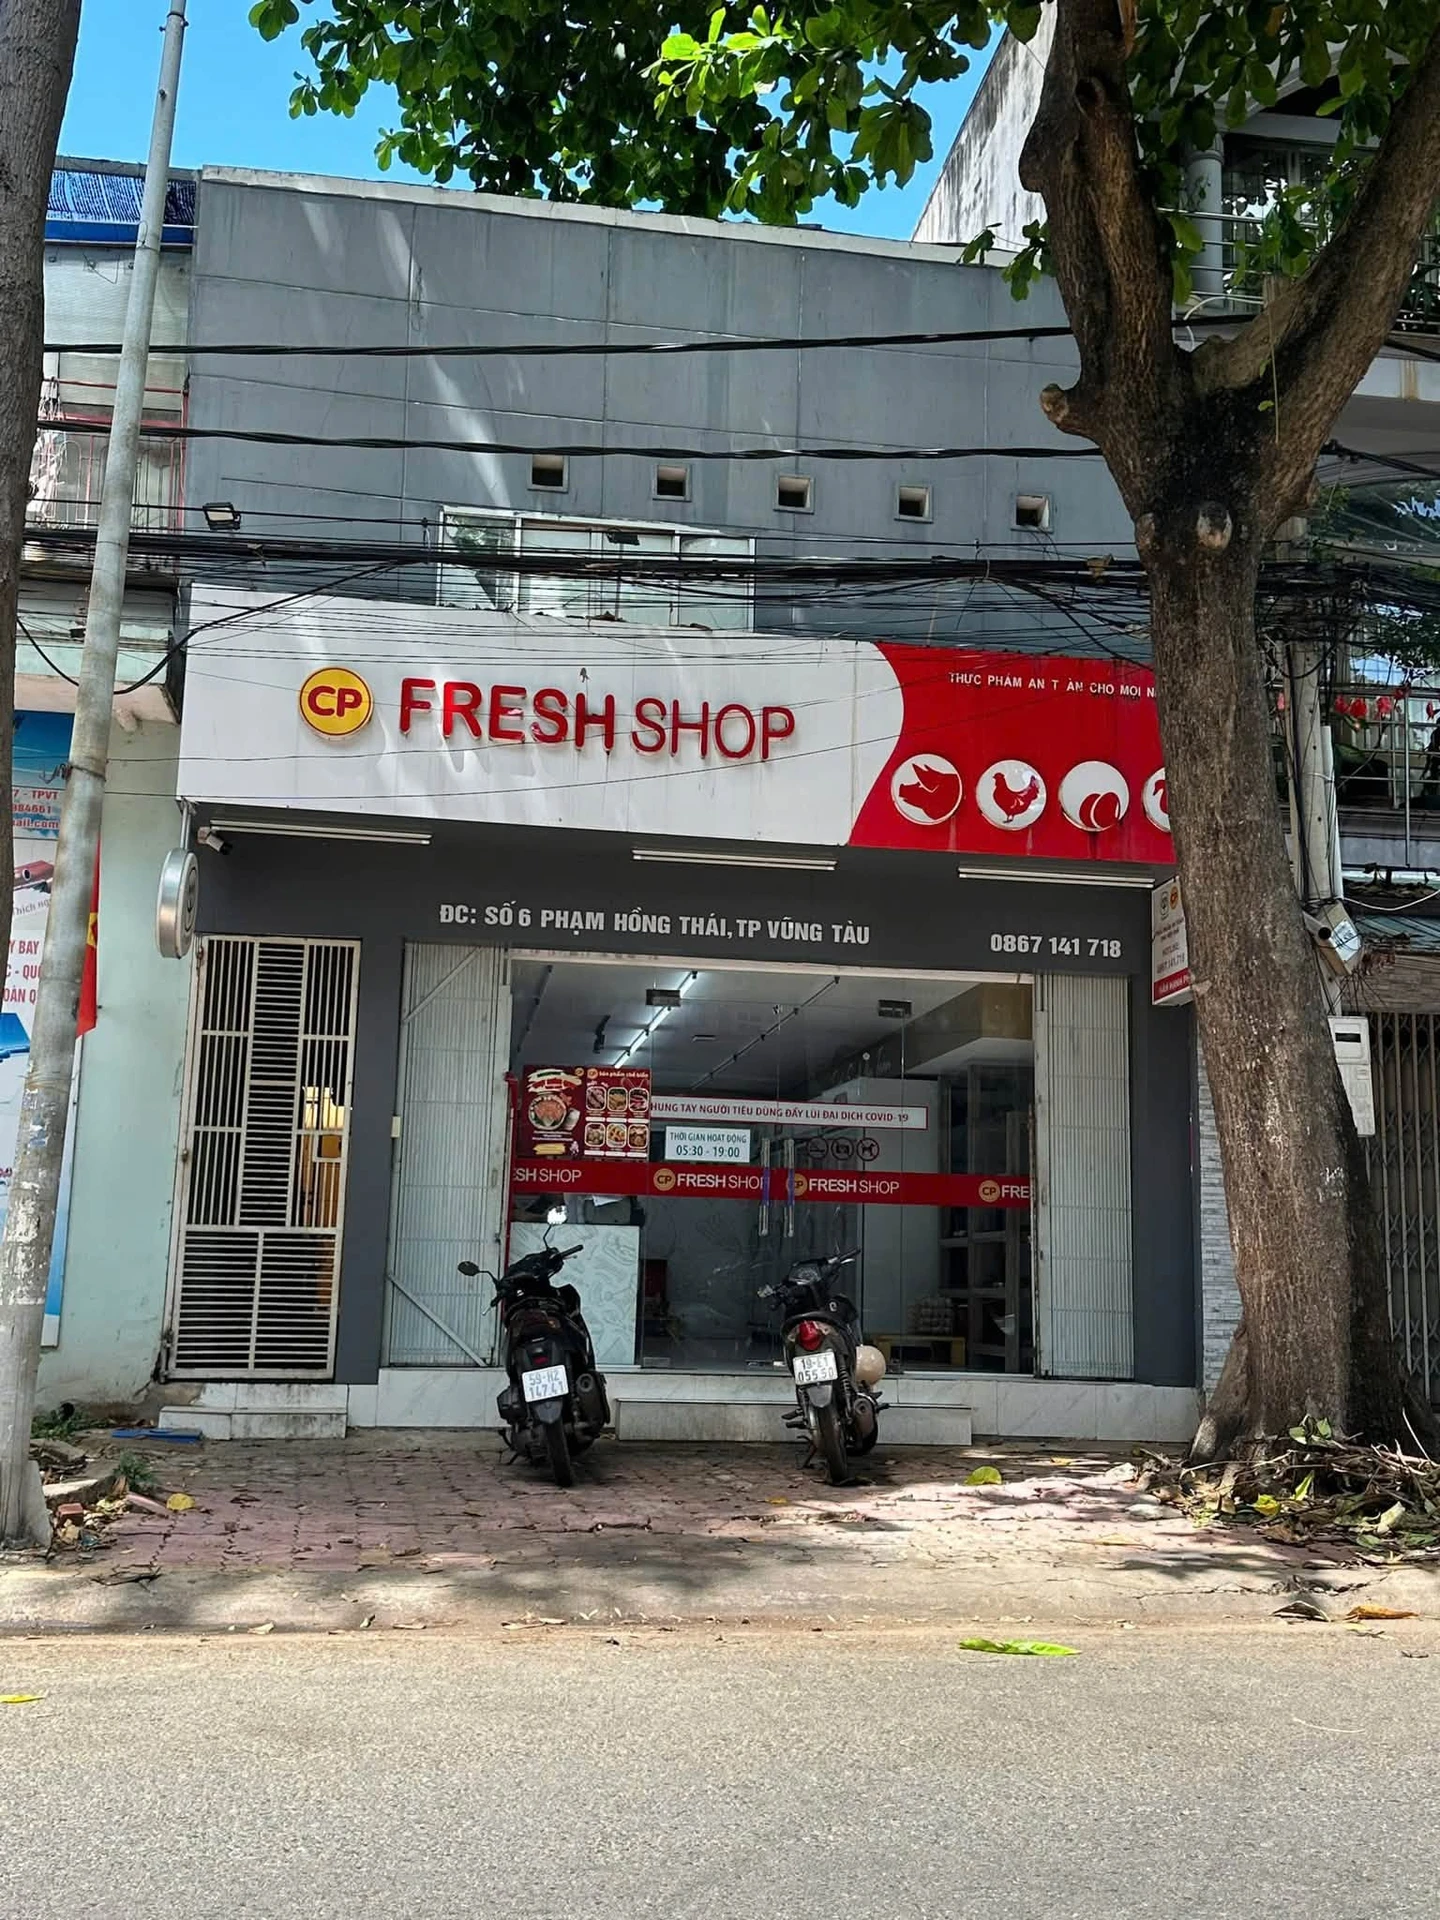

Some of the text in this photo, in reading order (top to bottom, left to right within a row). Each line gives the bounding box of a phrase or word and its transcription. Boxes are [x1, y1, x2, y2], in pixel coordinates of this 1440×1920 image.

[1028, 678, 1045, 690] AN
[1089, 682, 1115, 695] CHO
[307, 685, 363, 717] CP
[400, 677, 796, 761] FRESH SHOP
[439, 904, 476, 924] ĐC:
[484, 900, 517, 926] SỐ
[518, 908, 531, 927] 6
[540, 909, 605, 936] PHẠM
[614, 907, 671, 934] HỒNG
[767, 917, 823, 942] VŨNG
[832, 920, 870, 945] TÀU
[18, 941, 40, 954] BAY
[990, 934, 1121, 958] 0867 141 718
[681, 1103, 697, 1113] TAY
[687, 1133, 704, 1142] GIAN
[676, 1145, 704, 1156] 05:30
[713, 1146, 740, 1158] 19:00
[539, 1168, 582, 1183] SHOP
[657, 1175, 672, 1185] CP
[677, 1173, 726, 1188] FRESH
[808, 1178, 857, 1193] FRESH
[859, 1180, 900, 1194] SHOP
[982, 1187, 997, 1195] CP
